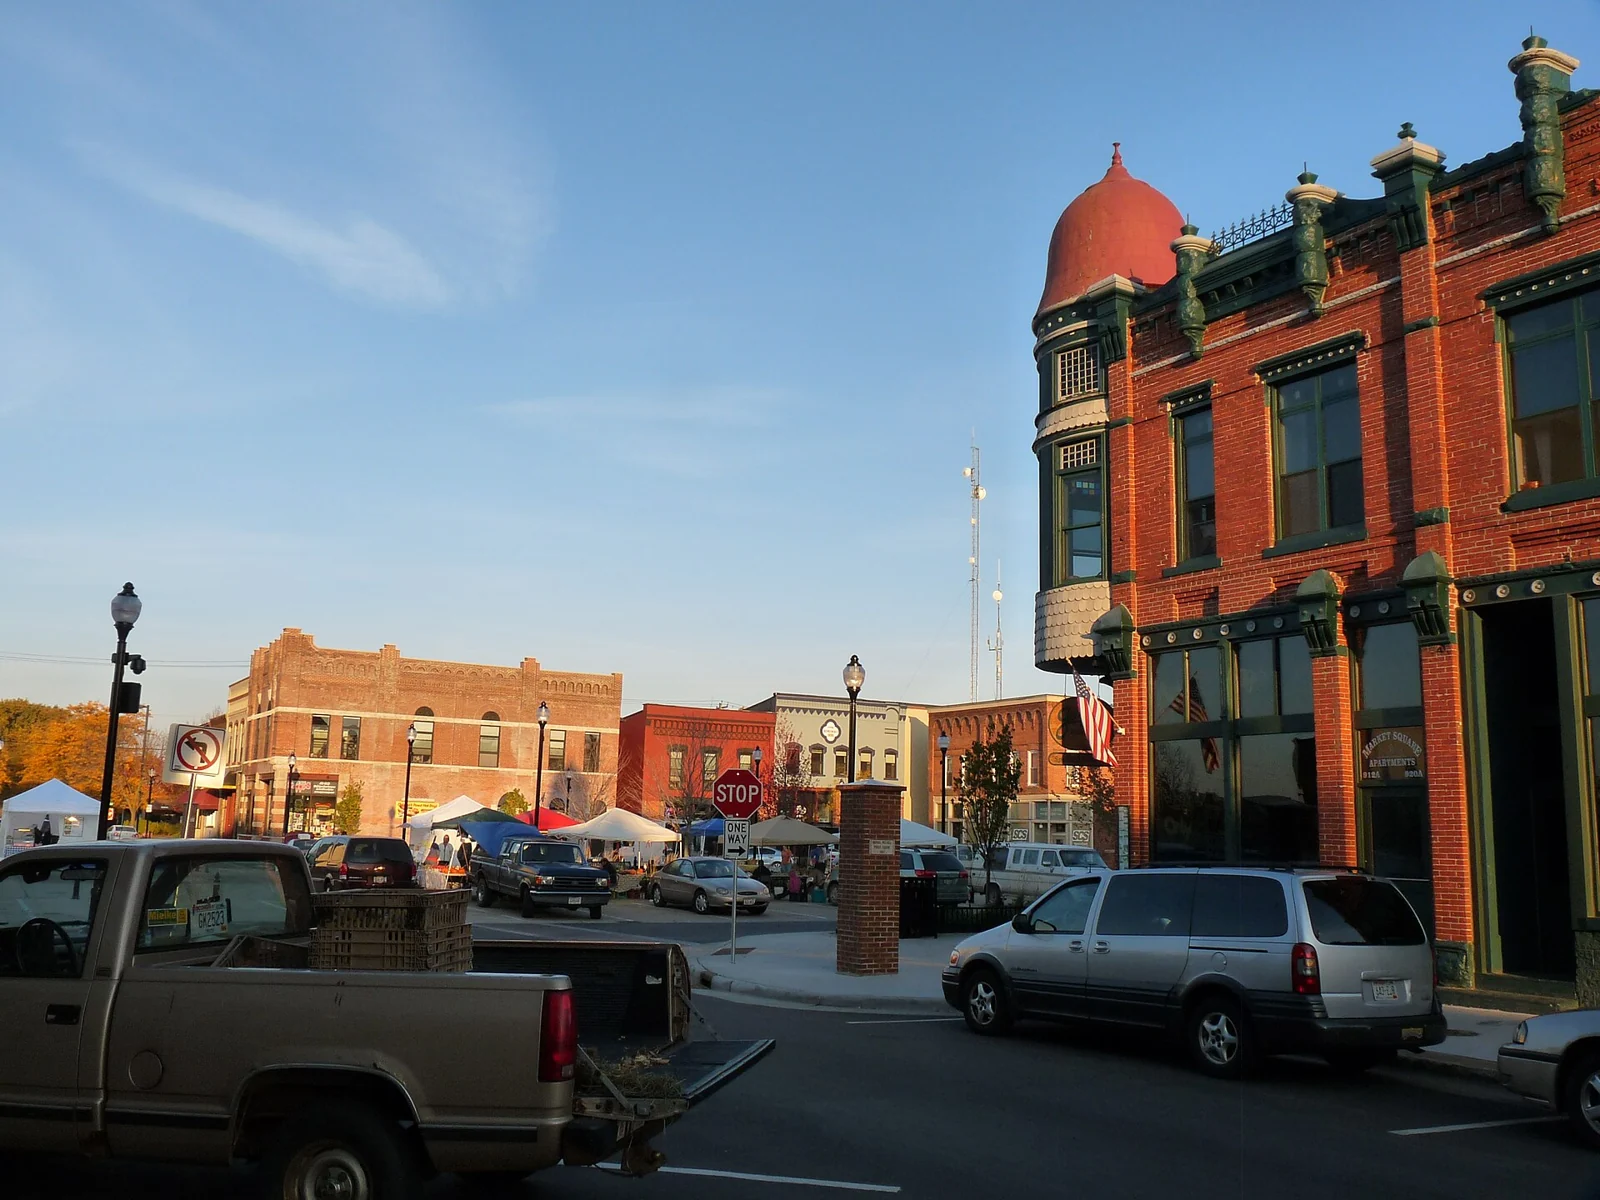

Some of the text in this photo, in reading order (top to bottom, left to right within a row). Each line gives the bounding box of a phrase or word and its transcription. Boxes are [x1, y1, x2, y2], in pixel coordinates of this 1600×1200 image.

[1362, 731, 1422, 759] MARKET SQUARE
[1369, 758, 1416, 768] APARTMENTS
[716, 784, 759, 803] STOP
[727, 823, 747, 833] ONE
[1013, 829, 1028, 839] SCS
[1073, 831, 1090, 841] SCS
[728, 835, 747, 844] WAY
[149, 911, 177, 920] Mielke
